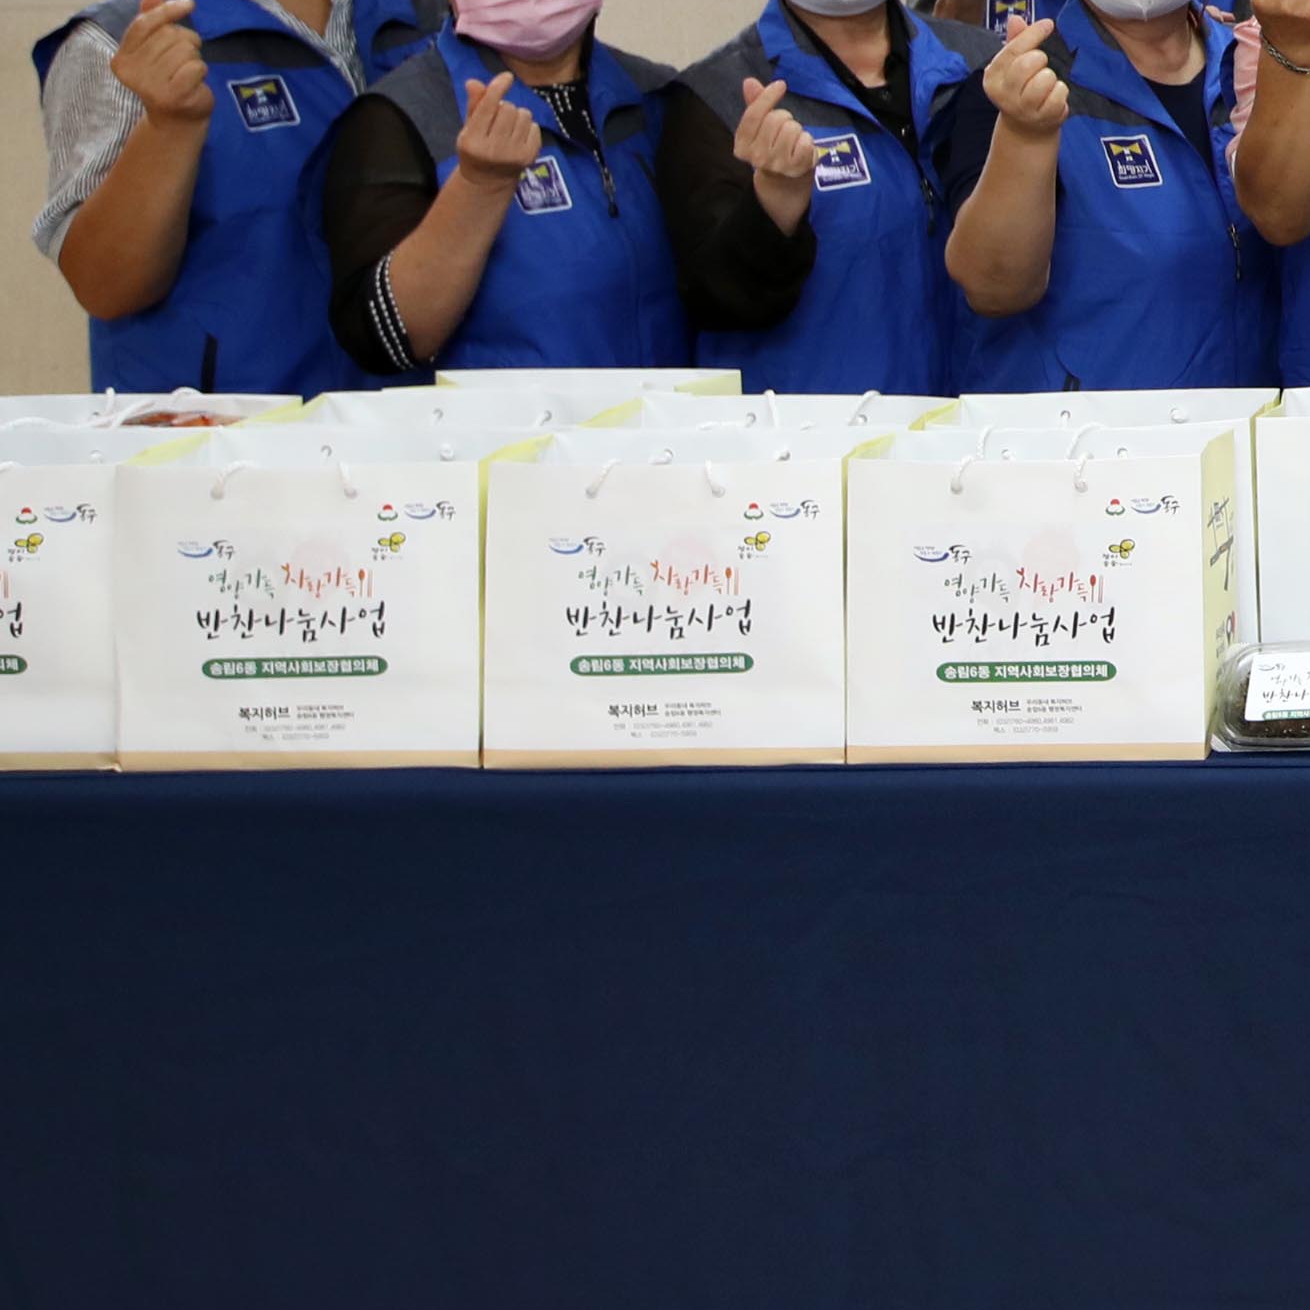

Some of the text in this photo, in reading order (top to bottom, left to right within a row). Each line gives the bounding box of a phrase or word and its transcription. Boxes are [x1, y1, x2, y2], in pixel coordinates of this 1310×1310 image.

[208, 567, 276, 599] 영양가득
[578, 565, 645, 595] 영양가득
[944, 573, 1011, 604] 영양가득
[196, 601, 387, 642] 반찬나눔사업
[566, 599, 753, 641] 반찬나눔사업
[932, 606, 1117, 648] 반찬나눔사업
[238, 705, 291, 721] 복지허브
[607, 702, 660, 718] 복지허브
[970, 699, 1021, 714] 복지허브
